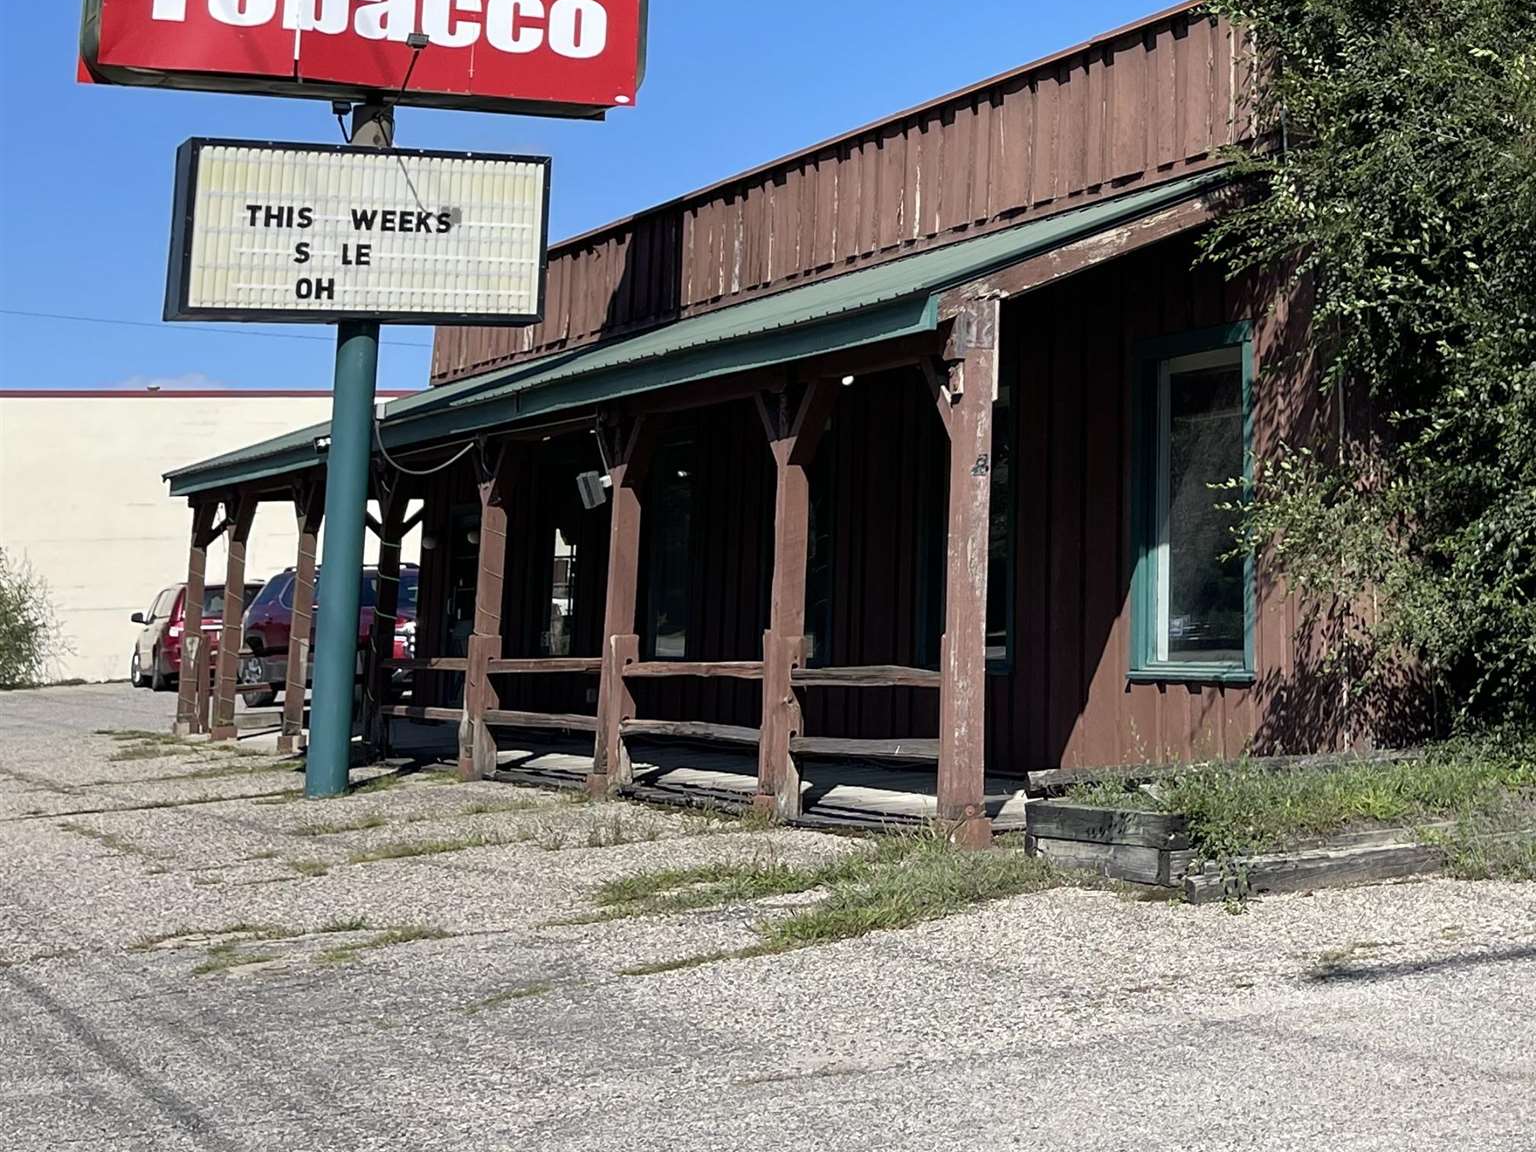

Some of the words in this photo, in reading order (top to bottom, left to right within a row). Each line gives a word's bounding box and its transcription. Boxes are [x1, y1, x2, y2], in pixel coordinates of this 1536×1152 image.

[246, 204, 313, 229] THIS
[351, 208, 452, 234] WEEKS
[295, 277, 335, 300] OH
